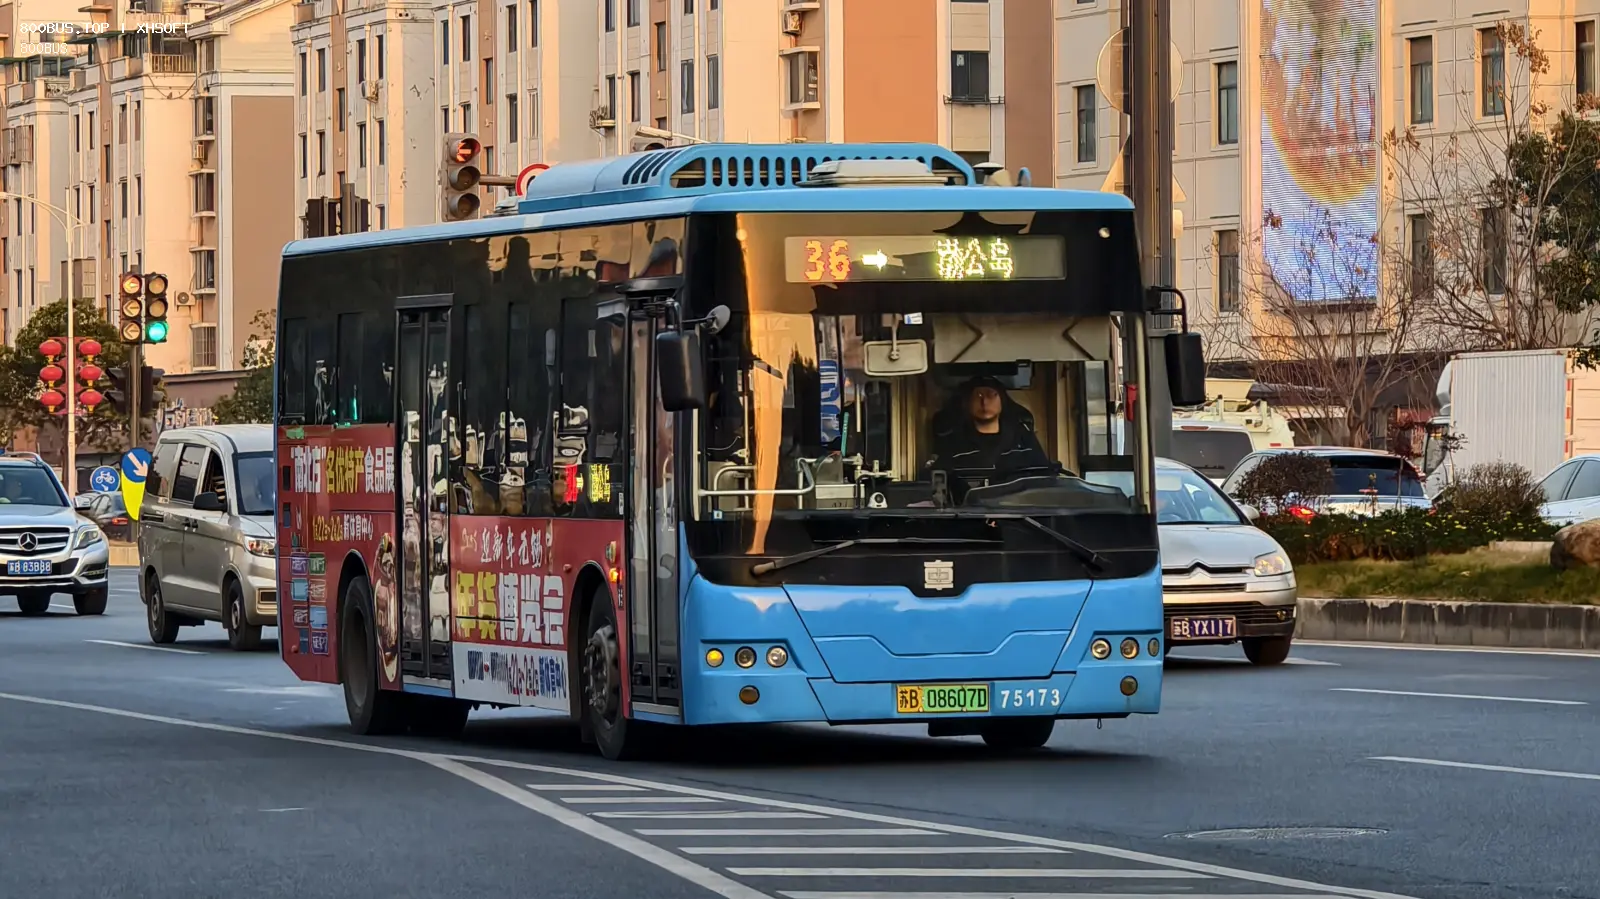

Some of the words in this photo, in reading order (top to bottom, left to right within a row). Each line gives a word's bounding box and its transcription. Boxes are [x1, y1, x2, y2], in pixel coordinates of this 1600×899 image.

[804, 239, 851, 281] 36
[455, 570, 565, 645] 年货博览会
[1000, 688, 1061, 709] 75173
